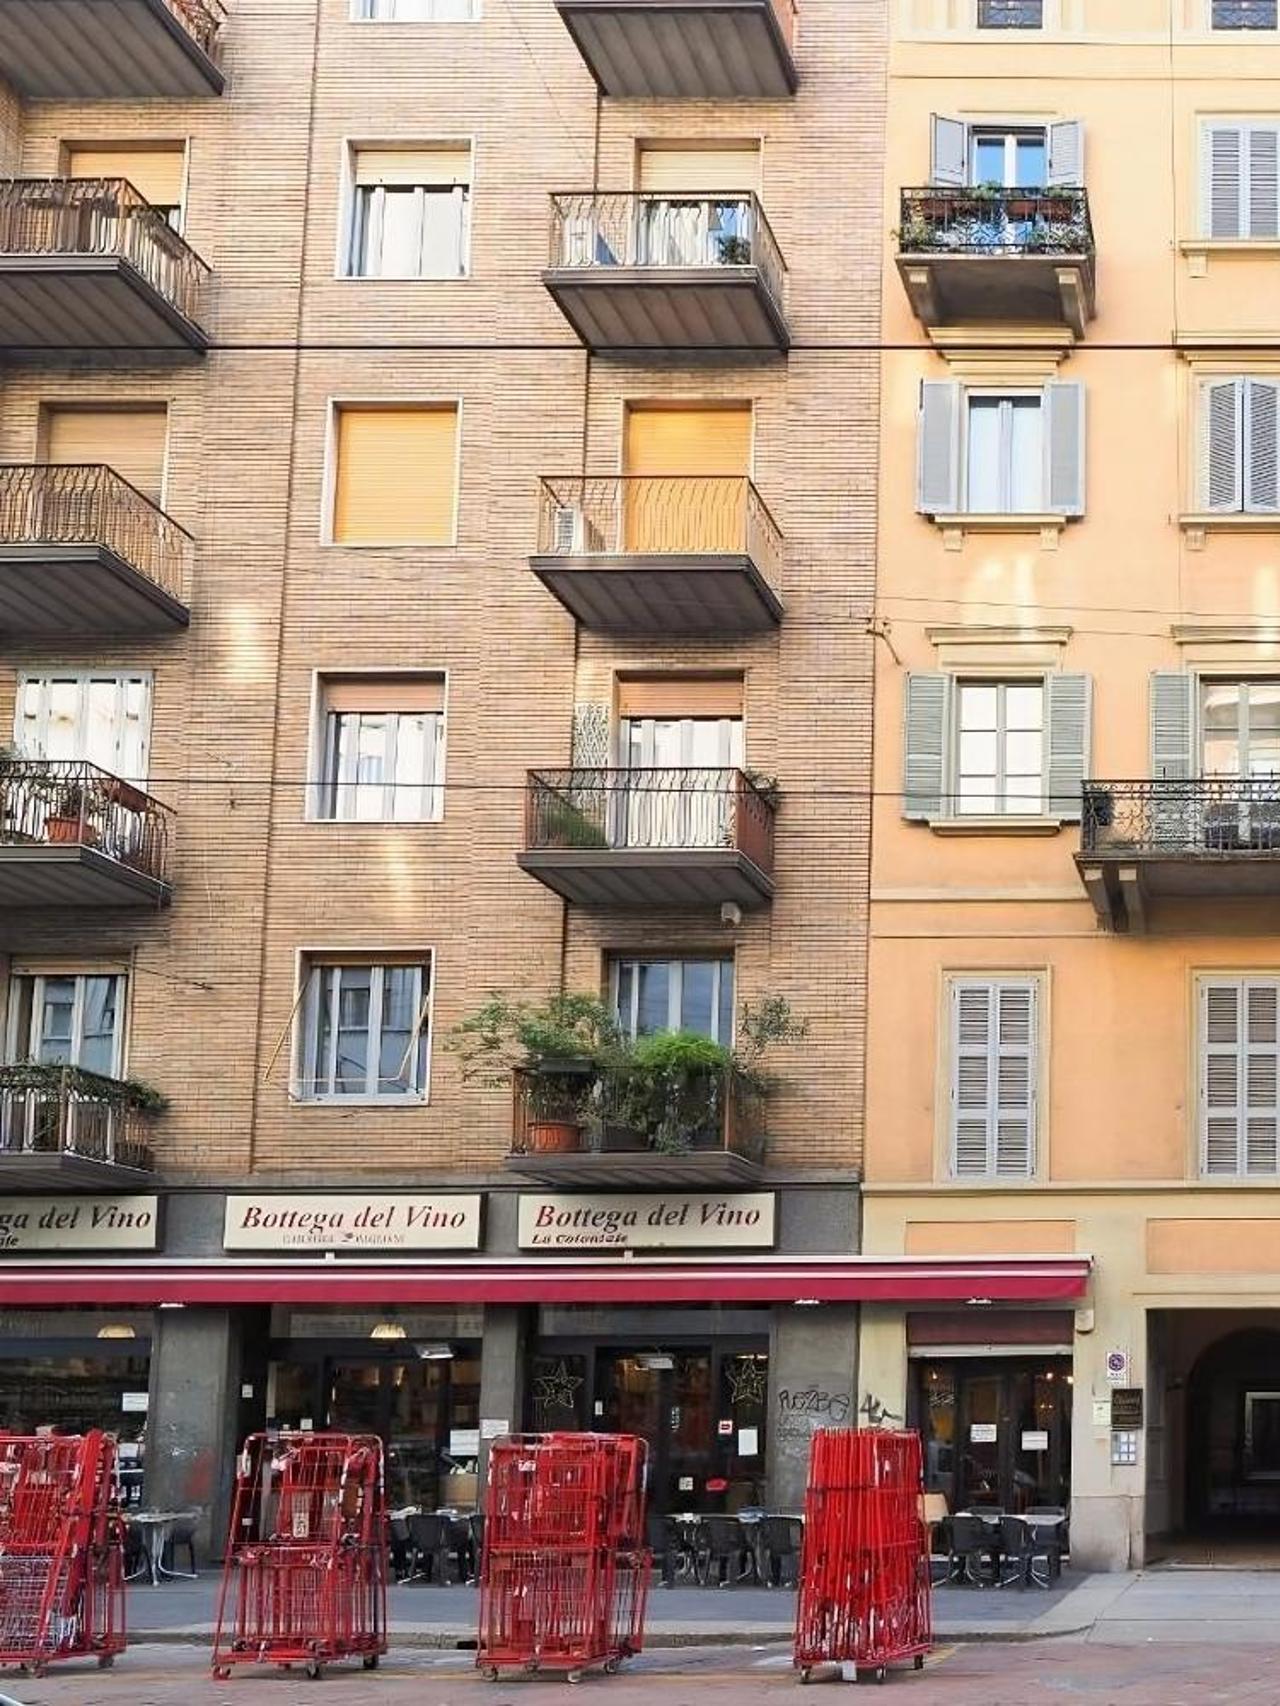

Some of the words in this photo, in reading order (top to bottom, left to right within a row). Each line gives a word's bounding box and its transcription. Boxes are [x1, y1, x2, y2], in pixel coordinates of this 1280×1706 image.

[38, 1205, 80, 1229] del
[91, 1205, 151, 1229] Vino
[240, 1206, 345, 1234] Bottega
[353, 1205, 396, 1228] del
[407, 1205, 466, 1229] Vino
[535, 1204, 638, 1233] Bottega
[647, 1203, 690, 1227] del
[700, 1202, 760, 1226] Vino
